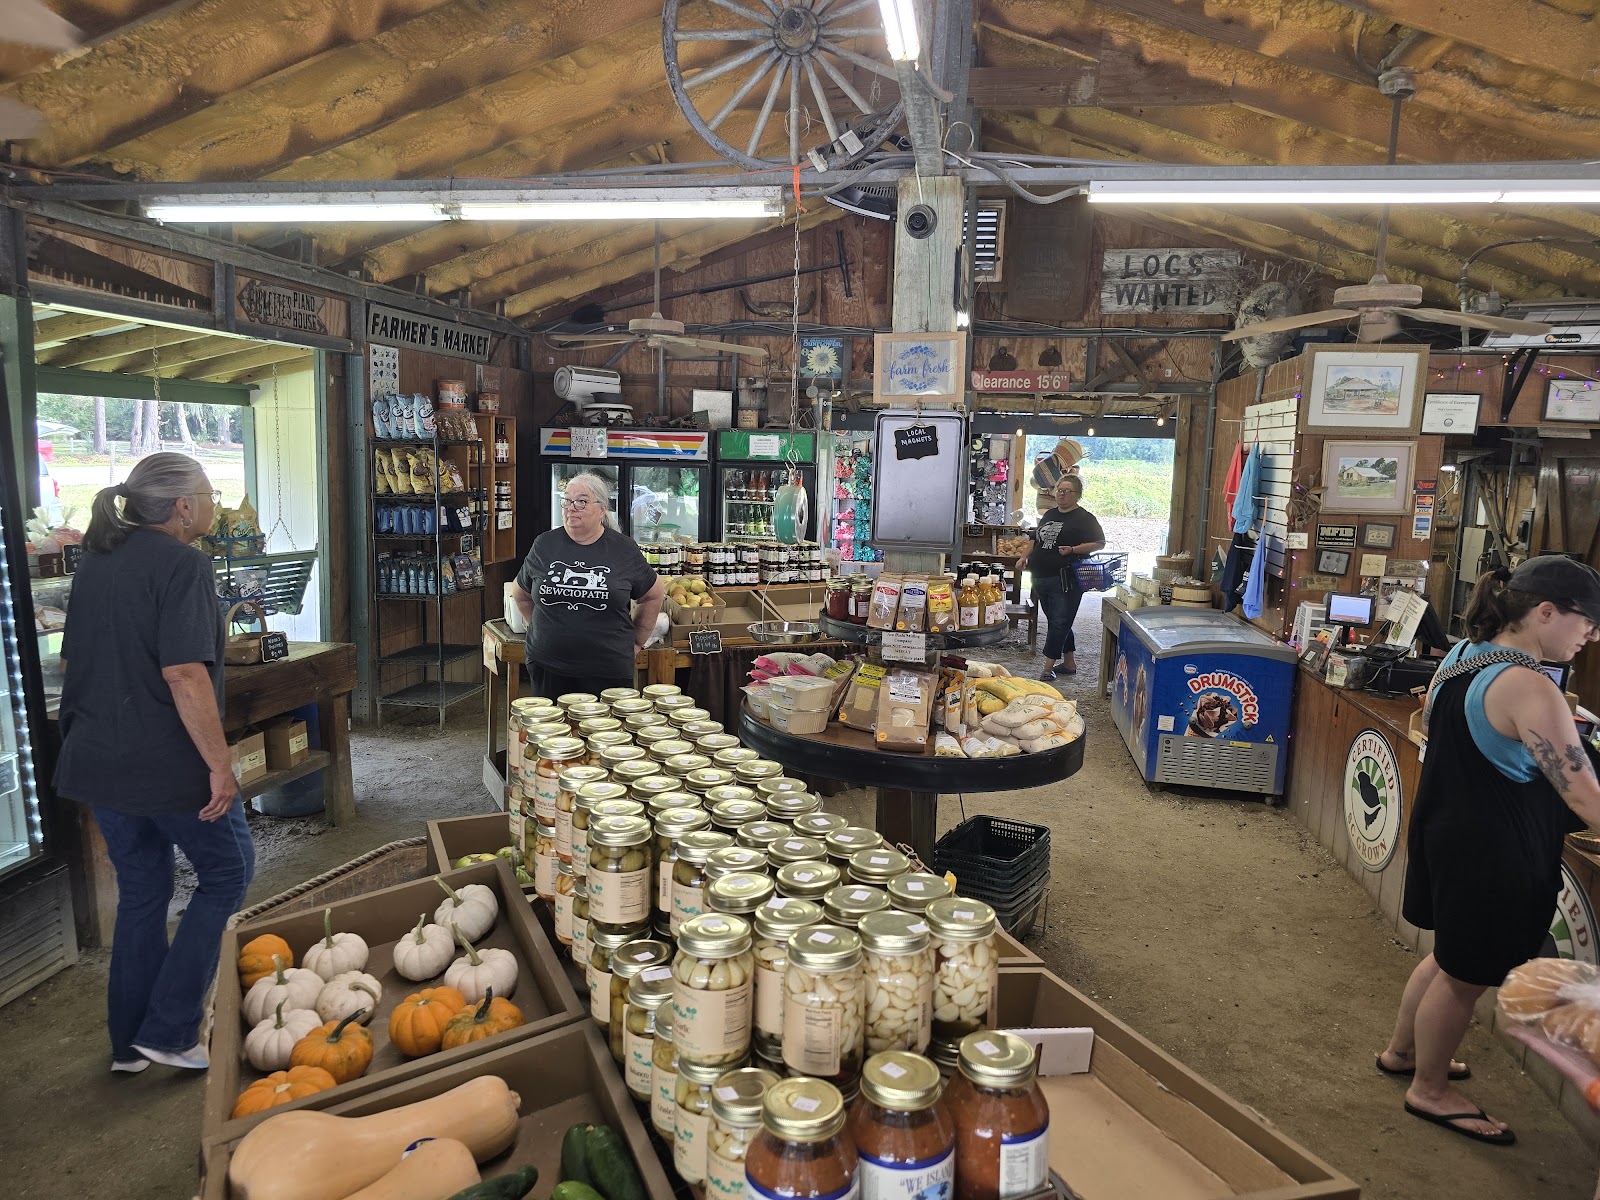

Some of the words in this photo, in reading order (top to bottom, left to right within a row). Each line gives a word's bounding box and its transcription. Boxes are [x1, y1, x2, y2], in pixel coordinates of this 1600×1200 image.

[1121, 254, 1203, 279] LOGS
[293, 291, 315, 313] PIANO
[1115, 283, 1216, 306] WANTED
[292, 310, 318, 331] HOUSE
[371, 312, 439, 347] FARMER'S
[442, 328, 490, 356] MARKET
[884, 361, 918, 380] farm
[922, 358, 952, 379] fresh
[971, 373, 1031, 389] Clearance
[900, 435, 933, 446] MAGNETS
[905, 428, 927, 438] LOCAL
[539, 584, 609, 600] SEWCIOPATH
[1188, 672, 1259, 724] DRUMSTICK
[1352, 739, 1395, 790] CERTIFIED
[1356, 838, 1388, 861] GROWN
